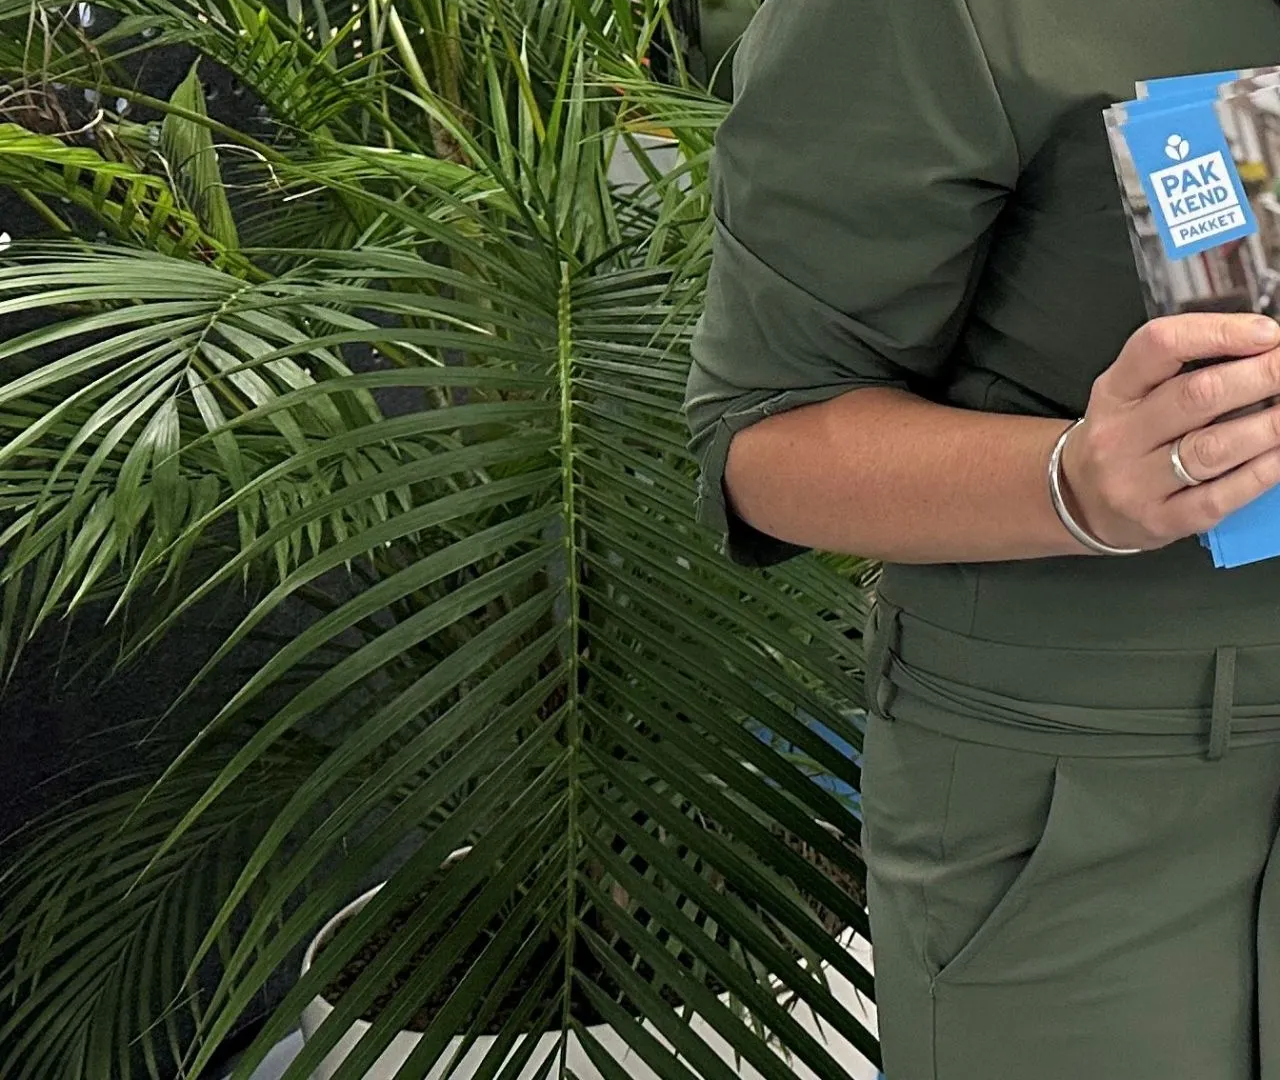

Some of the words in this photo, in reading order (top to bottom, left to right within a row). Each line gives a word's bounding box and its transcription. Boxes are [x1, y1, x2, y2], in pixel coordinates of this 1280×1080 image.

[1160, 159, 1220, 199] PAK
[1169, 186, 1229, 218] KEND
[1179, 211, 1237, 241] PAKKET
